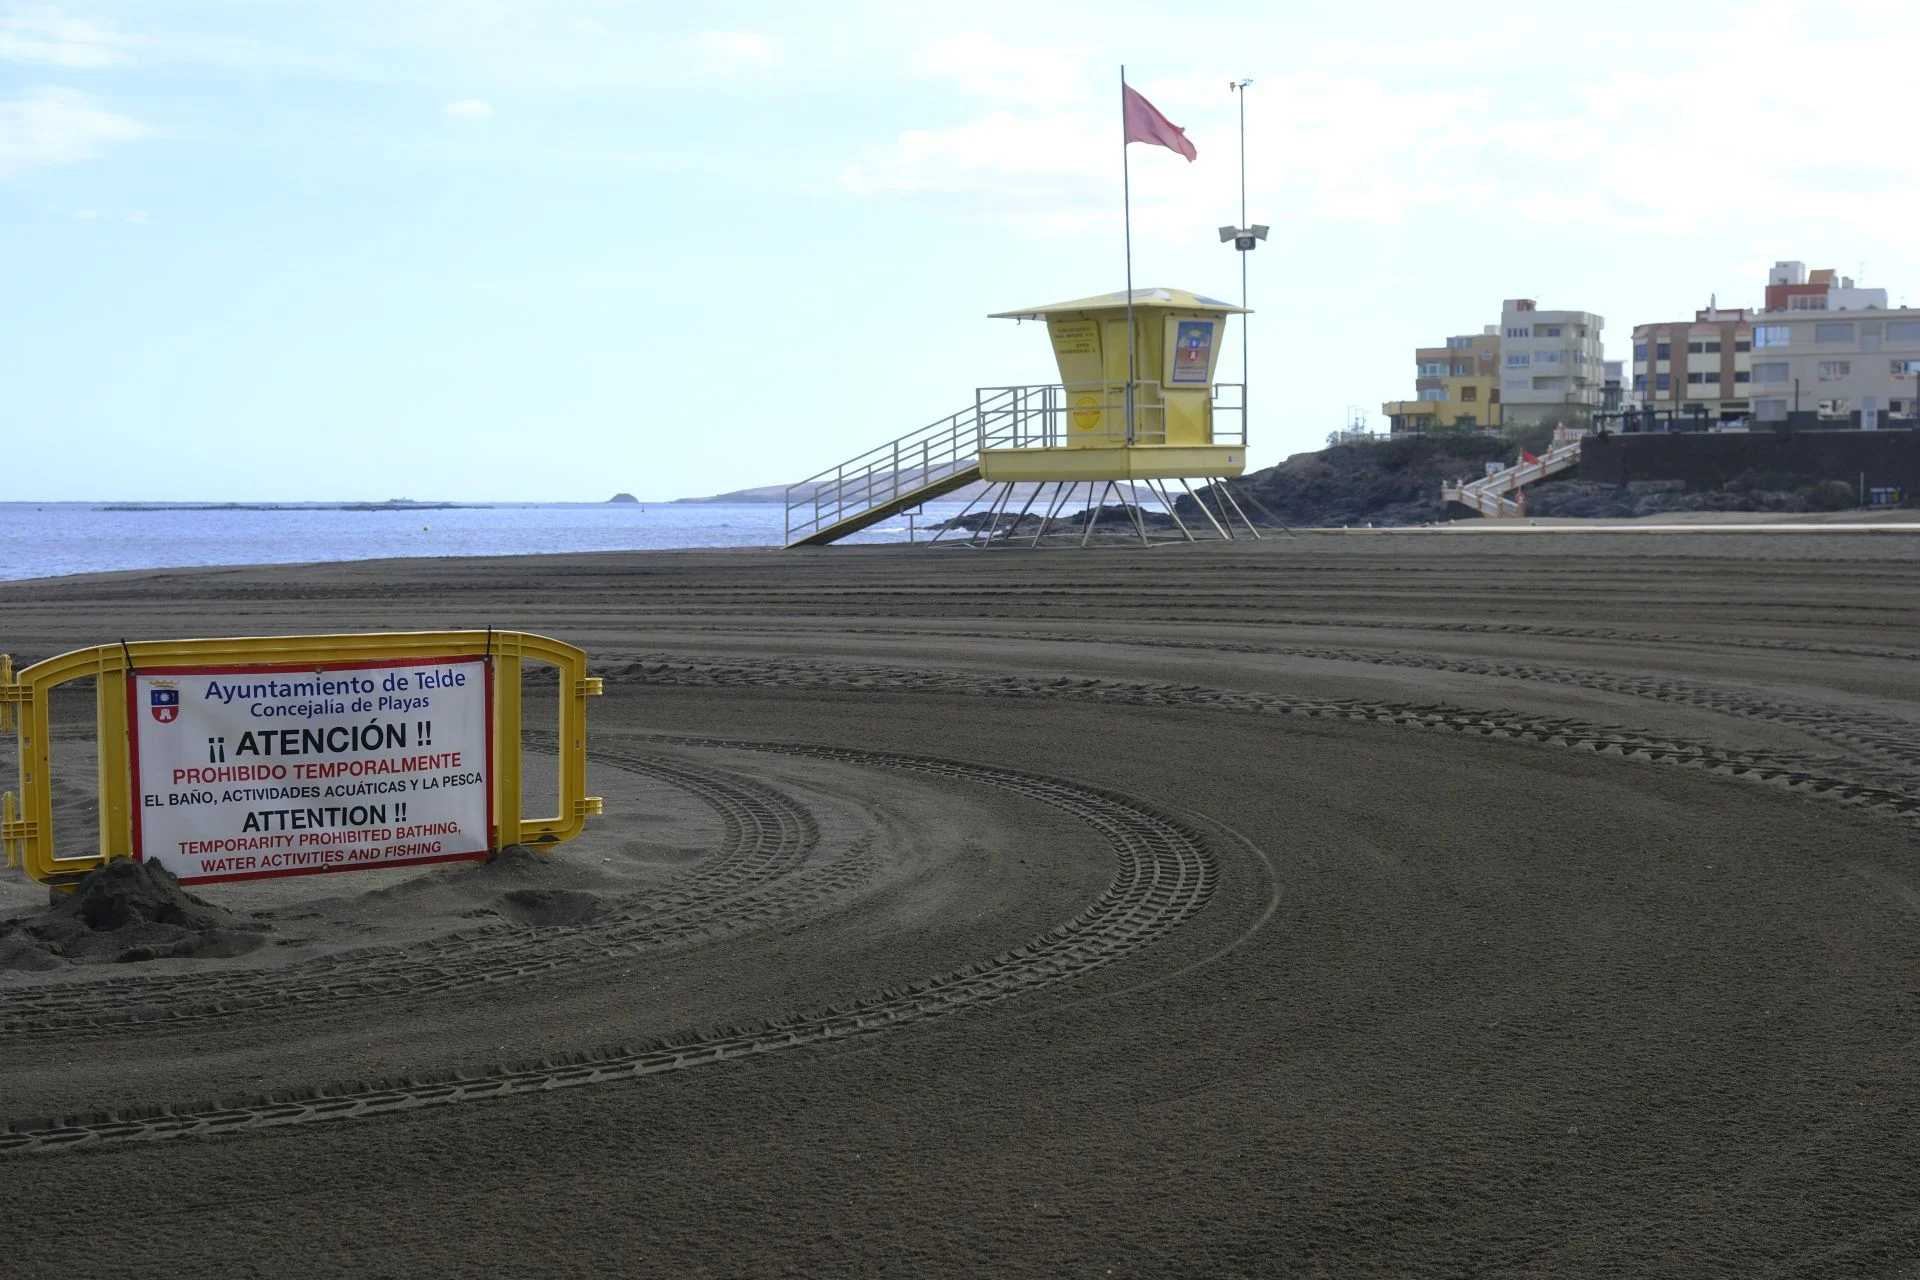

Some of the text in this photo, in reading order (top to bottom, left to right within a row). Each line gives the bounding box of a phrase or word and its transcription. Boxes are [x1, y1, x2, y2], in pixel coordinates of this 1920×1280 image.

[205, 669, 466, 704] Ayuntamiento de Telde
[250, 696, 430, 719] Concejalía de Playas
[208, 717, 432, 763] ¡¡ ATENCIÓN !!
[173, 752, 461, 785] PROHIBIDO TEMPORALMENTE
[144, 772, 483, 807] EL BAÑO, ACTIVIDADES ACUÁTICAS Y LA PESCA
[242, 802, 407, 833] ATTENTION !!
[178, 821, 462, 855] TEMPORARITY PROHIBITED BATHING,
[201, 841, 442, 873] WATER ACTIVITIES AND FISHING
